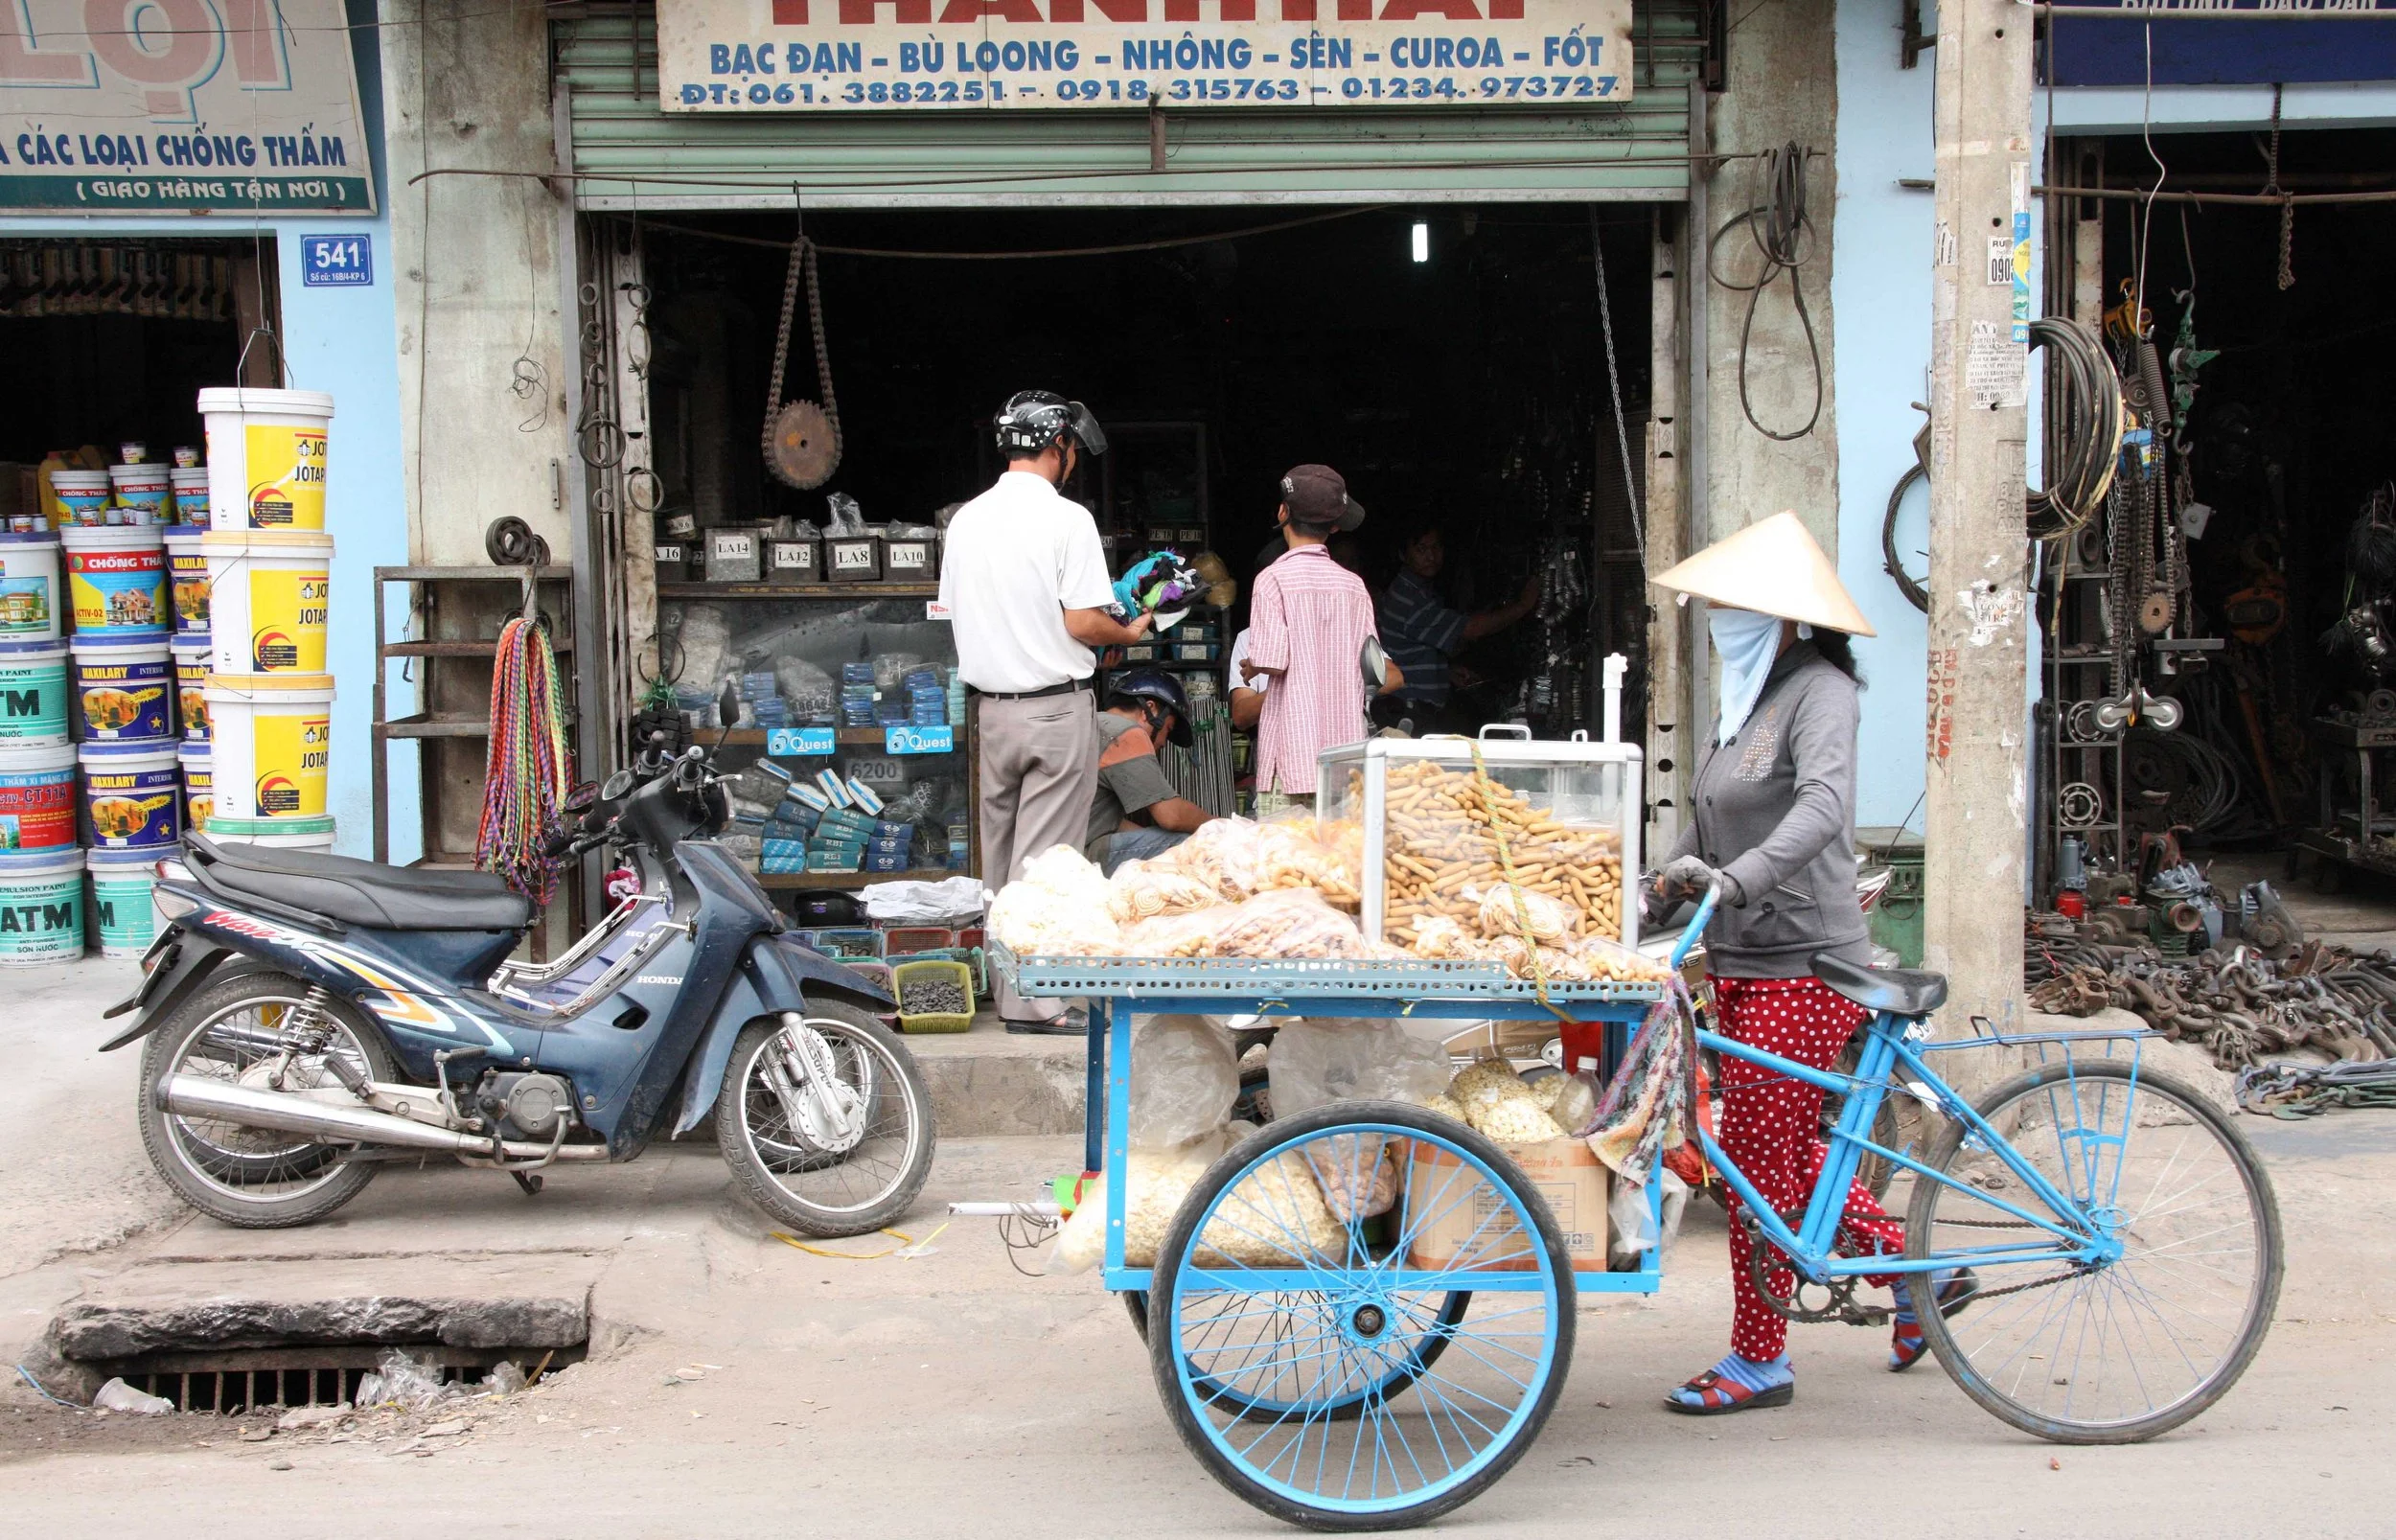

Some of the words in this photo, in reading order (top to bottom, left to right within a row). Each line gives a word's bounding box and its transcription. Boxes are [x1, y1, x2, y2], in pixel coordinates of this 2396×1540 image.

[710, 42, 775, 82] BẠC
[786, 41, 862, 81] ĐẠN
[899, 33, 944, 73] BÙ
[956, 39, 1079, 73] LOONG
[1122, 31, 1253, 71] NHÔNG
[1290, 30, 1352, 70] SÊN
[1390, 36, 1505, 69] CUROA
[1544, 23, 1603, 67] FỐT
[844, 80, 1003, 103] 3882251
[1480, 76, 1619, 98] 973727
[17, 125, 74, 166] CÁC
[79, 134, 150, 173] LOẠI
[156, 122, 256, 167] CHỐNG
[262, 122, 347, 166] THẤM
[158, 178, 226, 199] HÀNG
[315, 241, 359, 268] 541
[295, 466, 327, 483] JOTAP
[141, 555, 164, 567] THẤ
[298, 608, 328, 625] JOTAP
[790, 736, 833, 752] Quest
[909, 734, 951, 750] Quest
[852, 762, 897, 779] 6200
[1, 901, 73, 932] ATM
